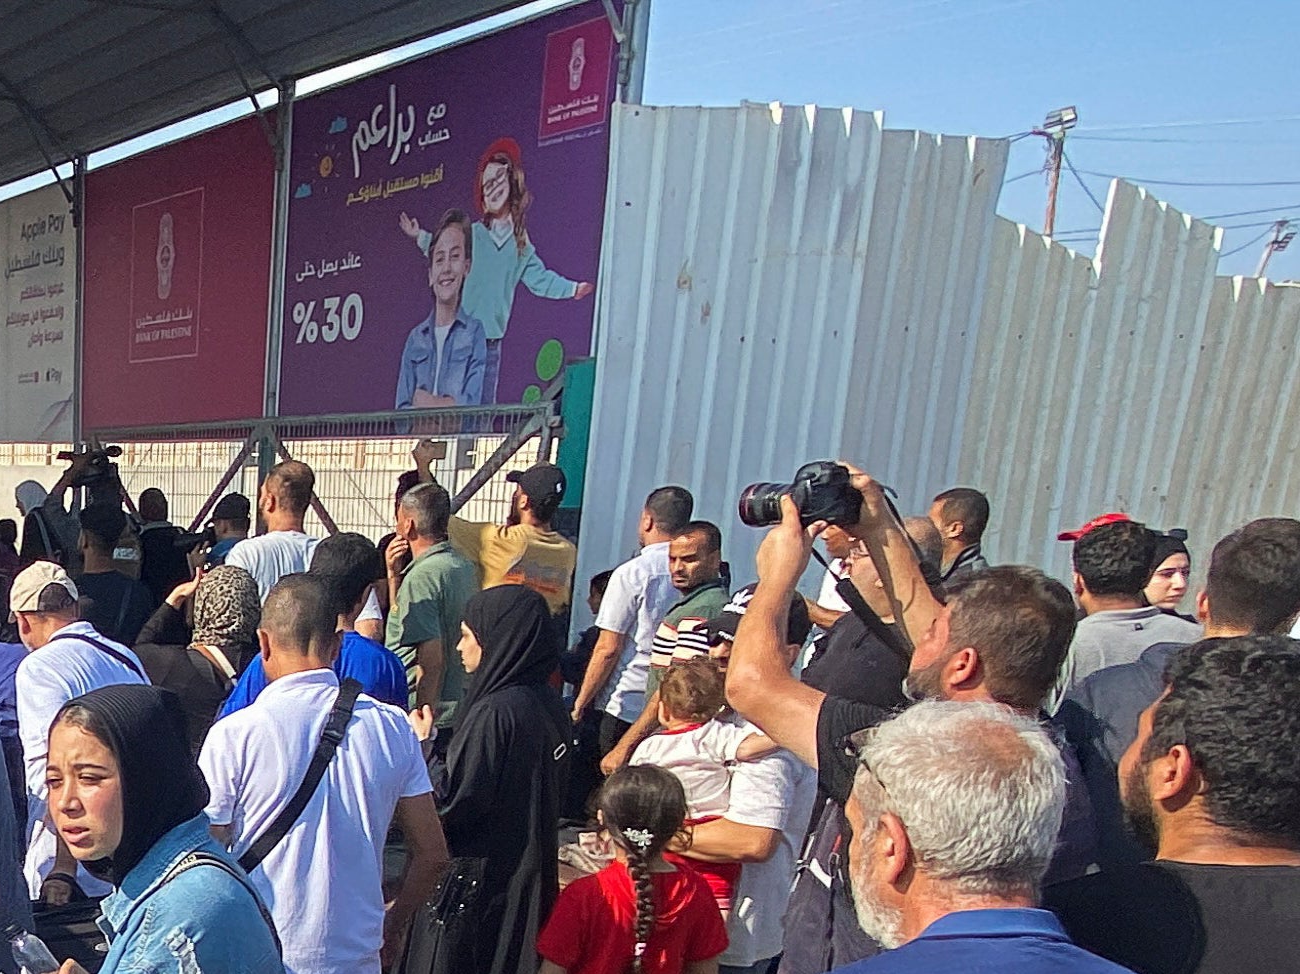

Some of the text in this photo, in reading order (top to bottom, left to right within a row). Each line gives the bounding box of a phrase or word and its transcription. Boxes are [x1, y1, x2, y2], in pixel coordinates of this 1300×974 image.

[427, 103, 446, 125] مع
[352, 84, 415, 179] براعم
[418, 128, 450, 151] حساب
[20, 214, 66, 241] Apple Pay
[295, 250, 362, 283] عائد يصل حتى
